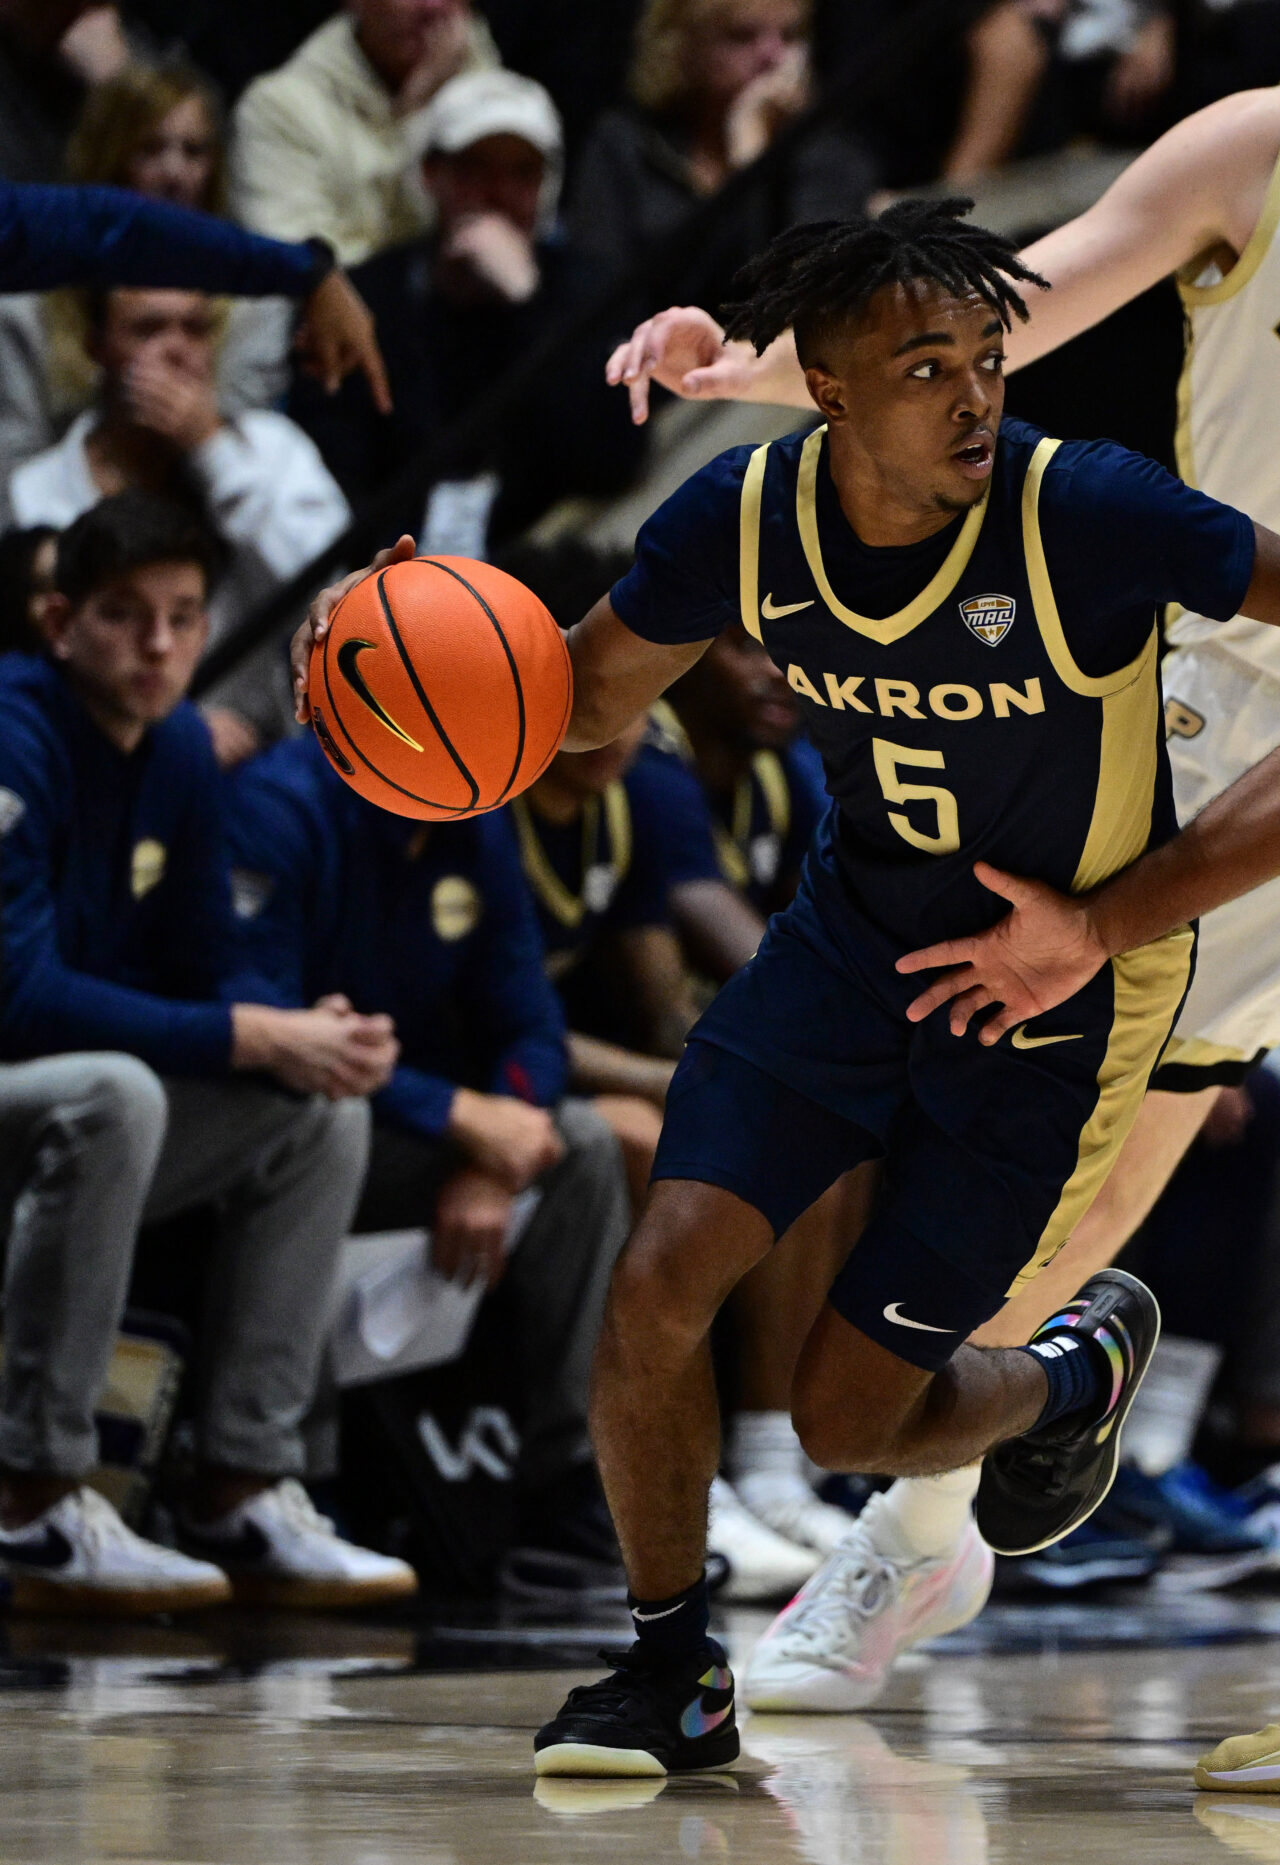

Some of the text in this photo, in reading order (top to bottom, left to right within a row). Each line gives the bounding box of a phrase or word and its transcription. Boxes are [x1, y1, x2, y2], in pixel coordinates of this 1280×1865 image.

[966, 609, 1013, 626] MAC
[787, 663, 1046, 721] AKRON
[872, 736, 961, 856] 5
